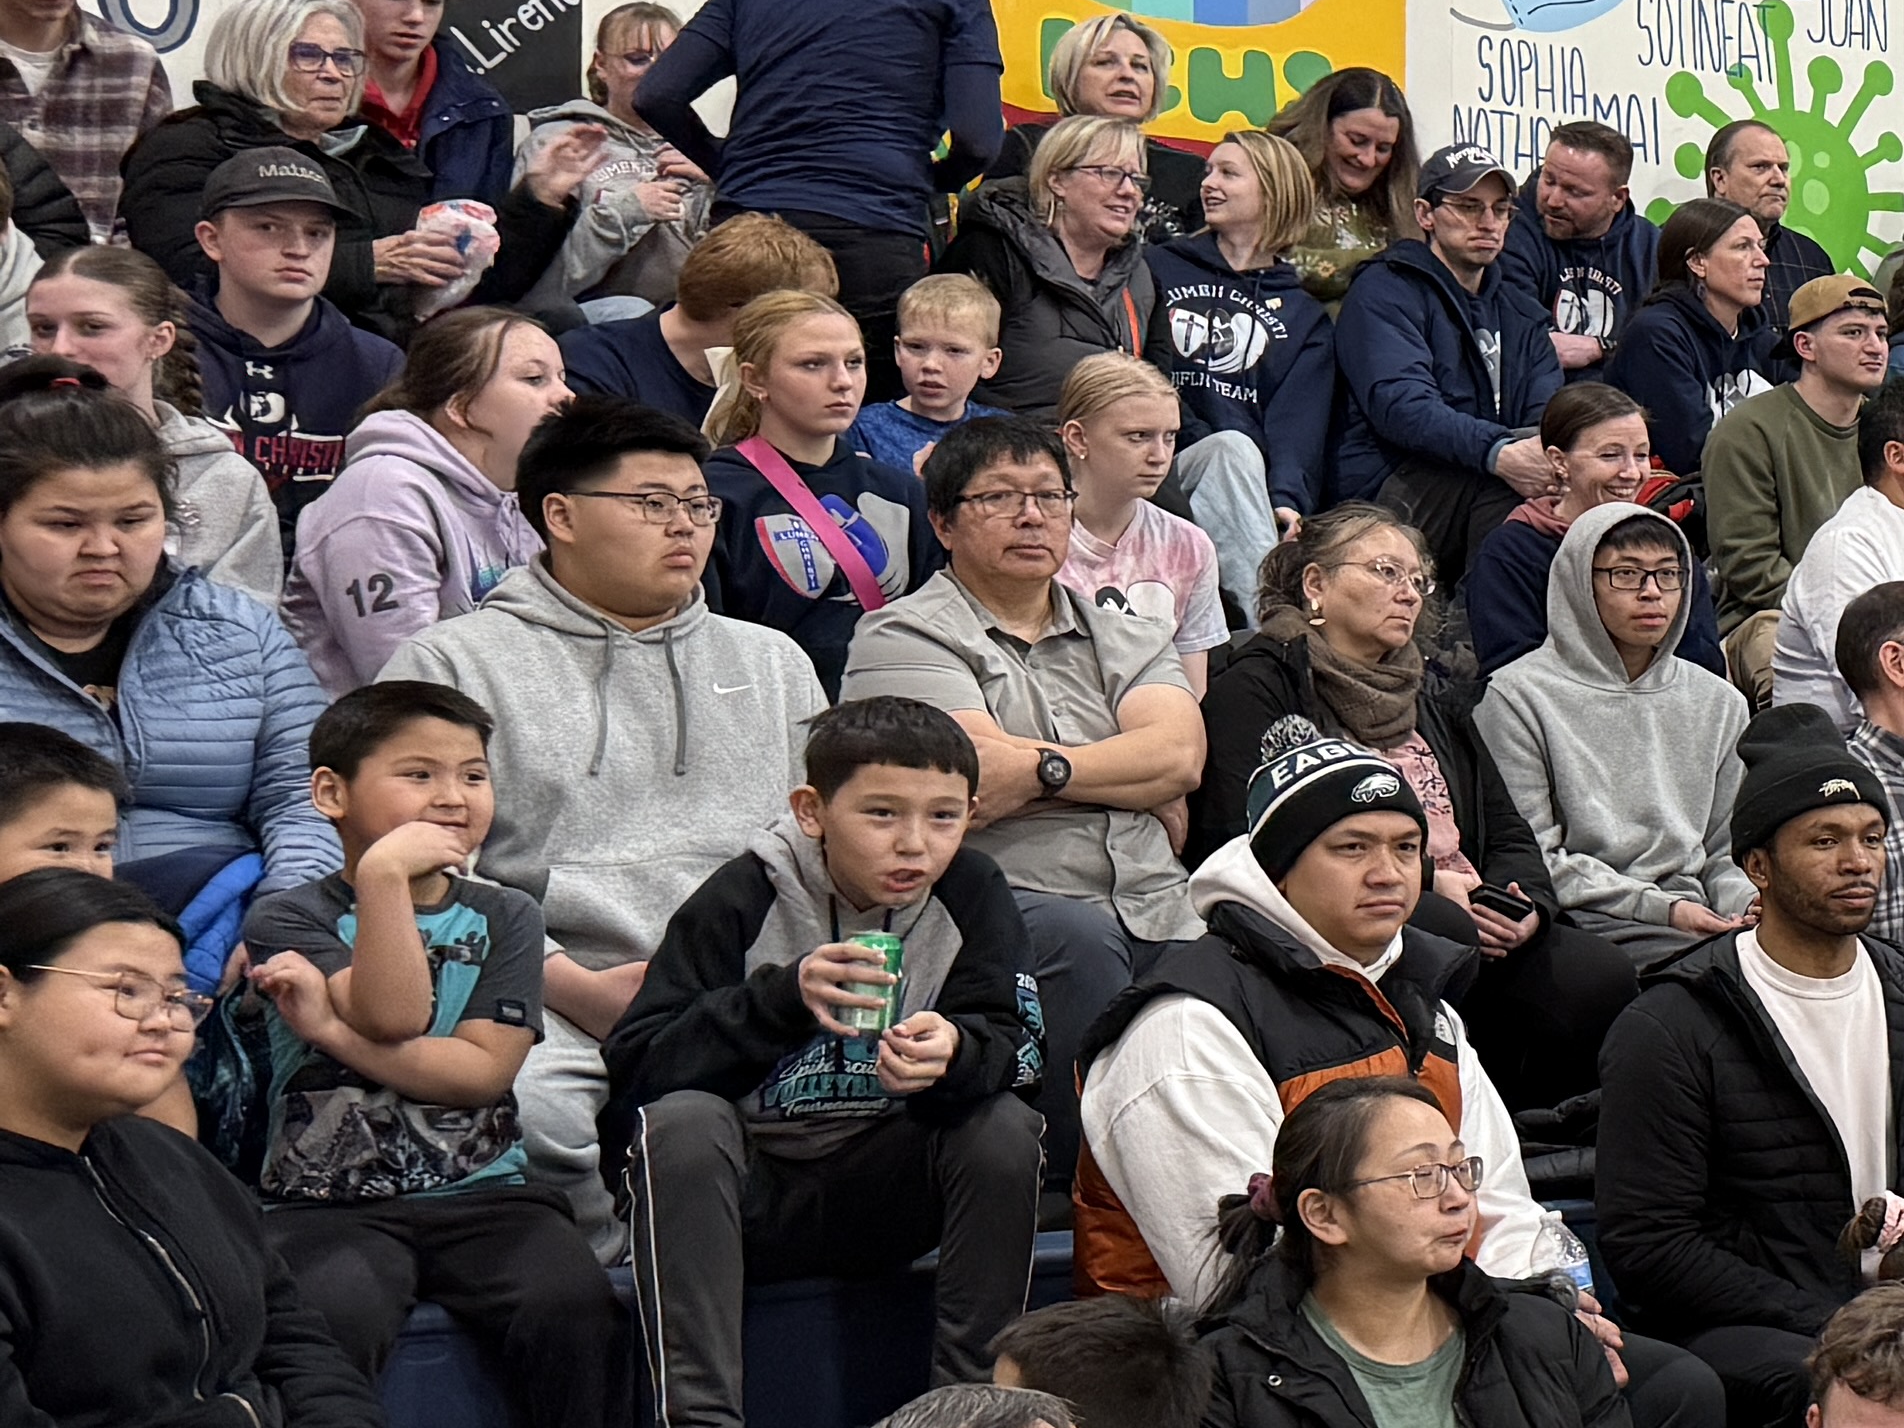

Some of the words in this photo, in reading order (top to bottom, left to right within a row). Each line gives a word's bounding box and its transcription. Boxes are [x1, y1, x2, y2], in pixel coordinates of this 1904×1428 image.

[1477, 35, 1588, 115] SOPHIA
[1592, 92, 1661, 166] MAI
[1212, 378, 1258, 404] TEAM
[346, 573, 399, 619] 12
